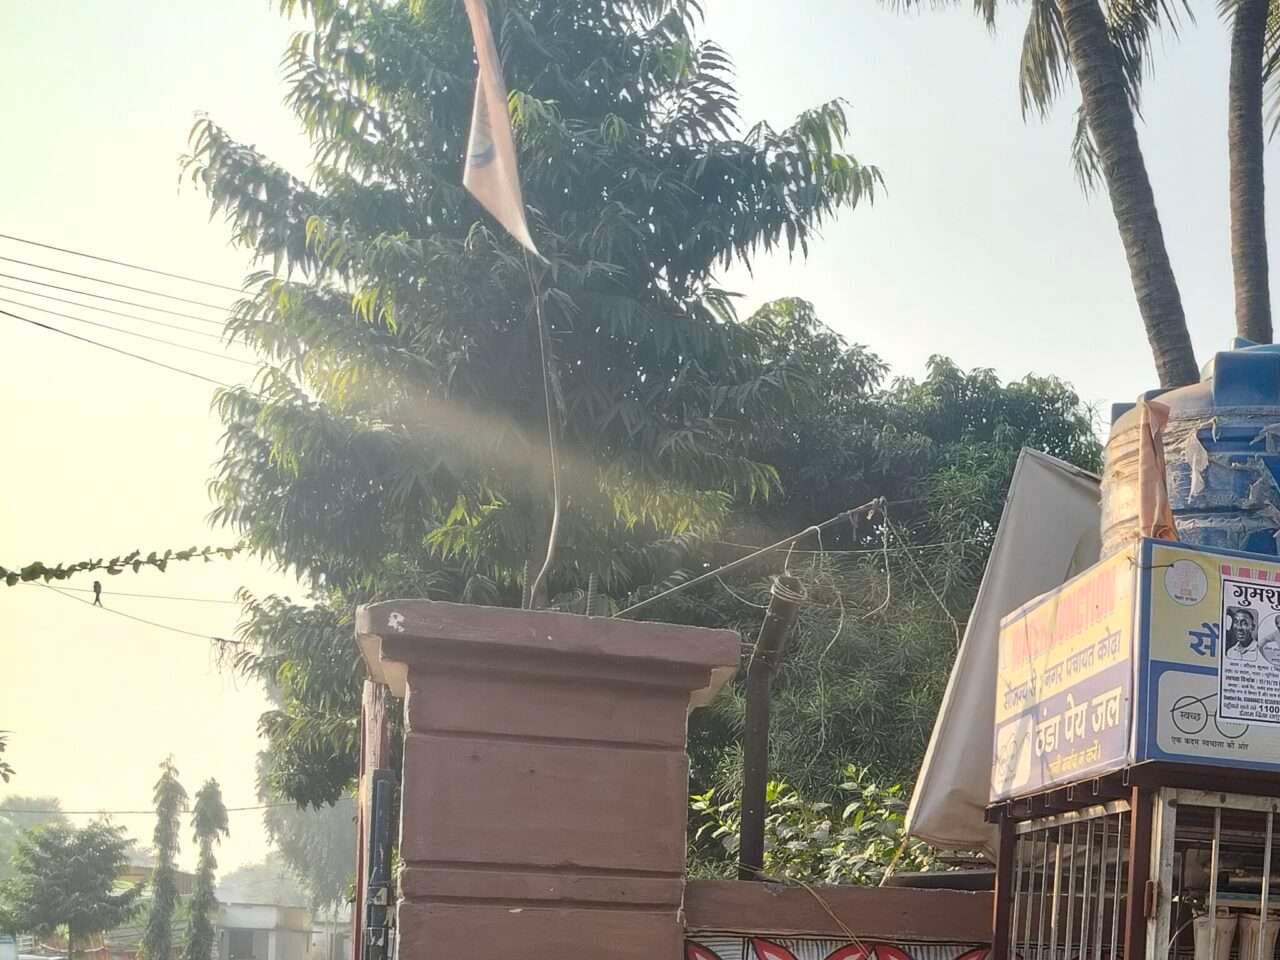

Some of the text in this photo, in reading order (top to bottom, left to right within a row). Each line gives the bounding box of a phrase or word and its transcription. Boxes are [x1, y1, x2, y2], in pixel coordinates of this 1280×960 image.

[1034, 687, 1122, 756] ठंडा पेय जल
